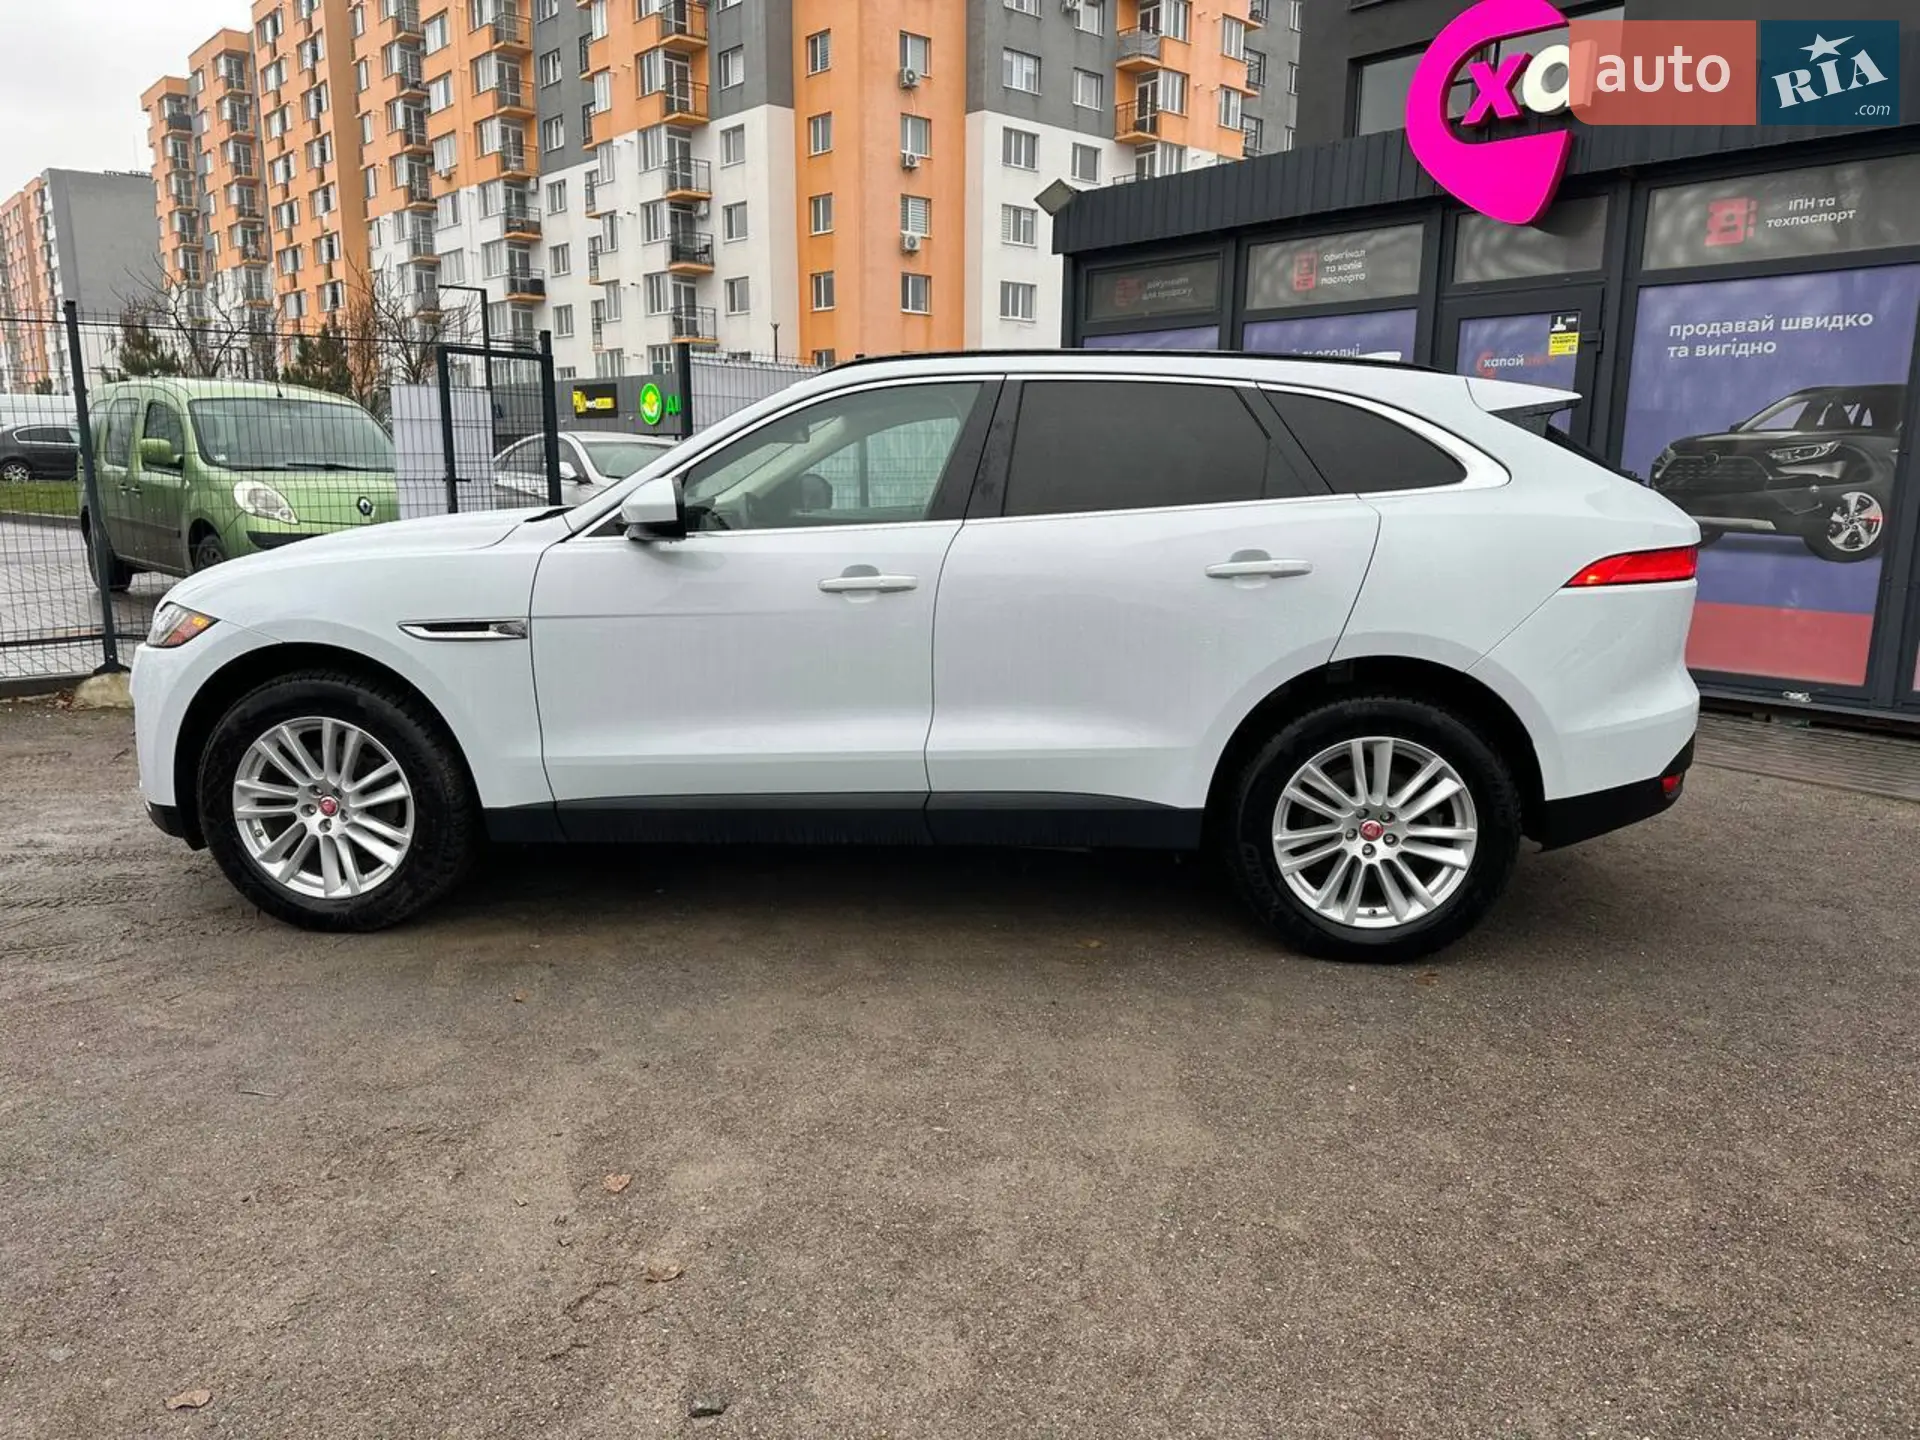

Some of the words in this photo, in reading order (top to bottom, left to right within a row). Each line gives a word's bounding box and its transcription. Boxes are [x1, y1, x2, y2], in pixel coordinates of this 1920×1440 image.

[1817, 197, 1836, 208] та
[1766, 209, 1857, 228] техпаспорт
[1669, 314, 1775, 341] продавай
[1780, 312, 1874, 332] швидко
[1667, 344, 1689, 358] та
[1694, 337, 1777, 358] вигідно
